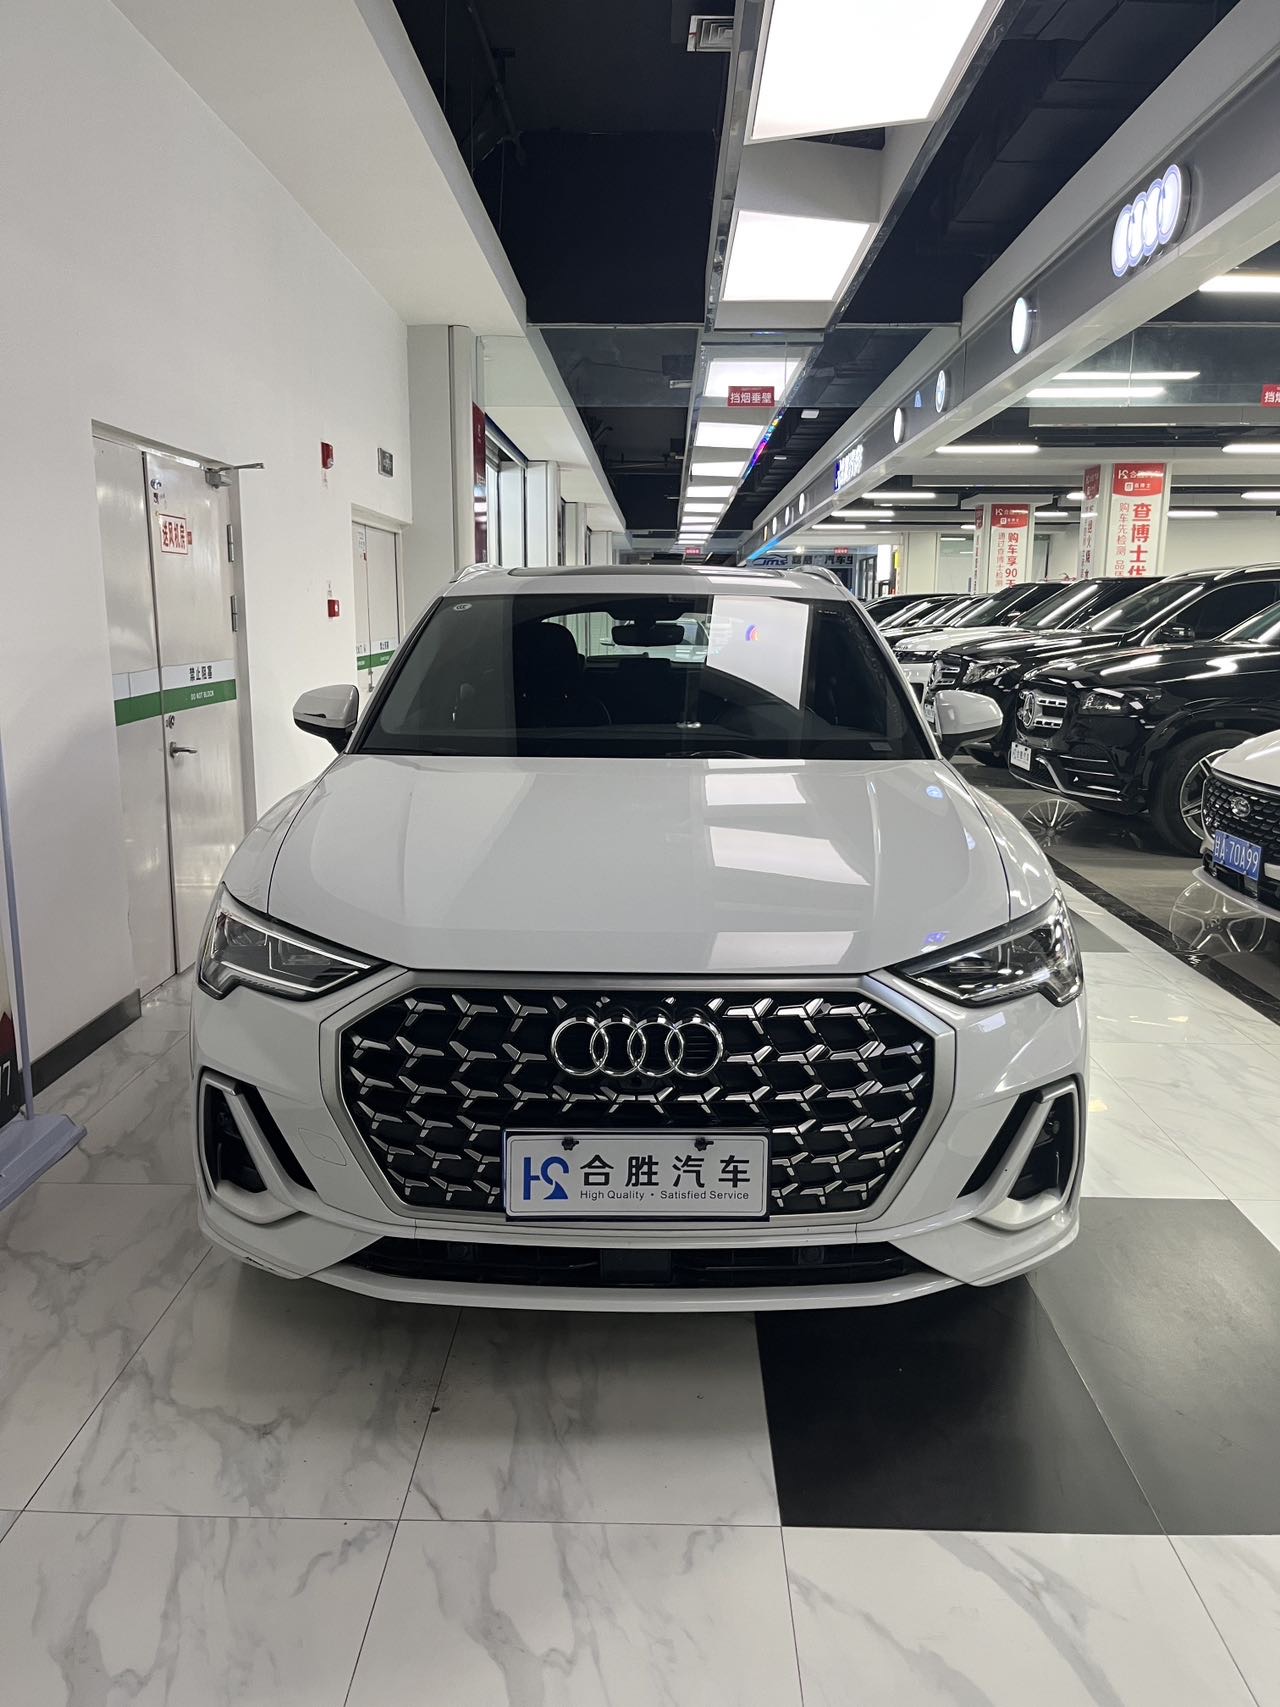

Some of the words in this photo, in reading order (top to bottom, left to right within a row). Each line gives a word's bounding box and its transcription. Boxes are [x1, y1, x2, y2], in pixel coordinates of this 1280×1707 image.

[730, 392, 772, 404] 挡烟垂壁
[580, 1154, 751, 1188] 合胜汽车
[580, 1190, 604, 1201] High
[607, 1190, 645, 1201] Quality
[660, 1190, 707, 1200] Satisfied
[709, 1190, 749, 1200] Service
